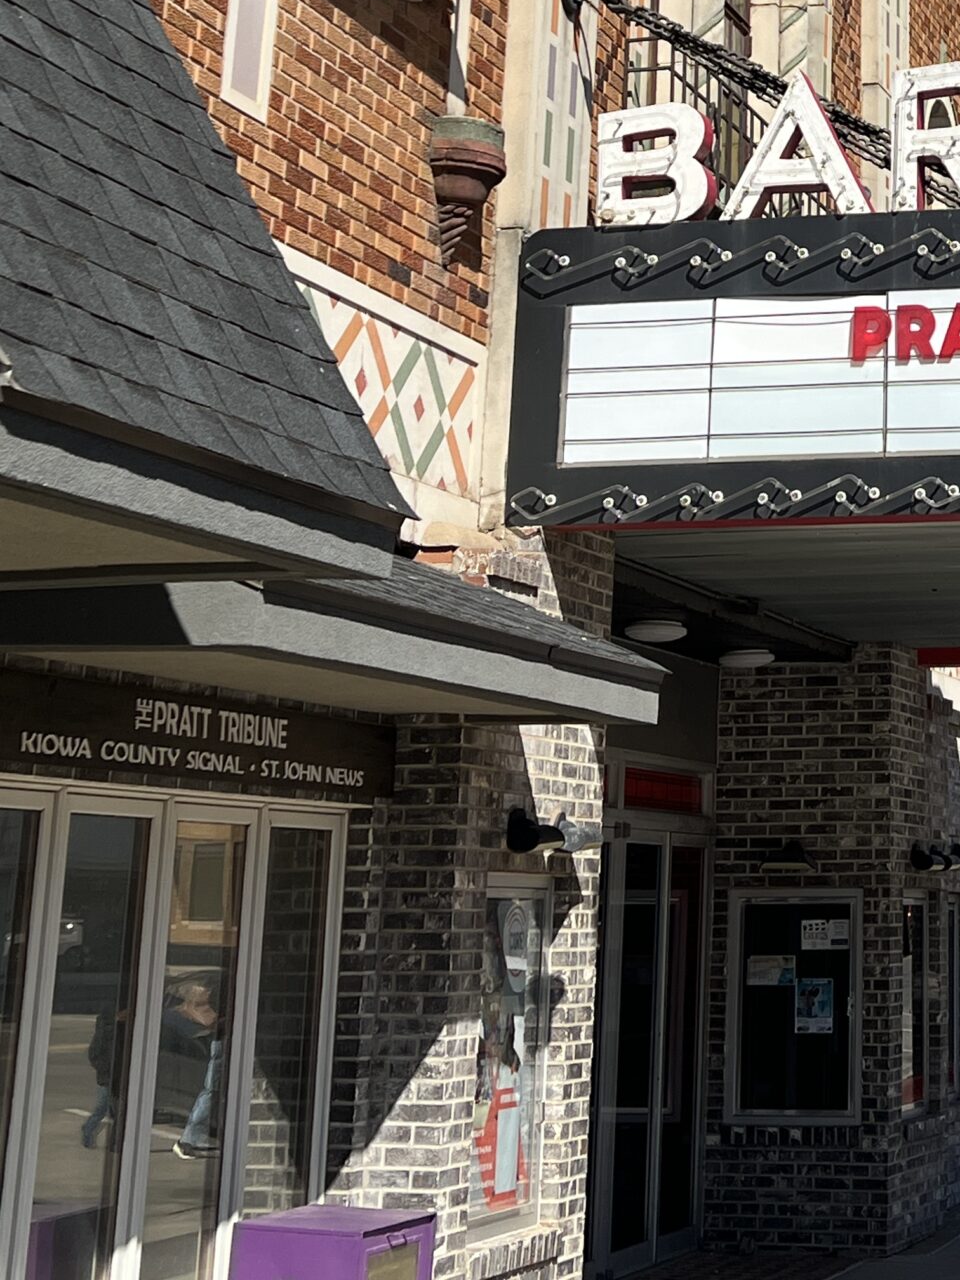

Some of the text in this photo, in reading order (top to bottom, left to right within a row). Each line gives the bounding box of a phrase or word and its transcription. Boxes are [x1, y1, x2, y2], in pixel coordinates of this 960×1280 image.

[135, 698, 288, 749] THE PRATT TRIBUNE
[20, 731, 365, 788] KIOWA COUNTY SIGNAL ST. JOHN NEWS
